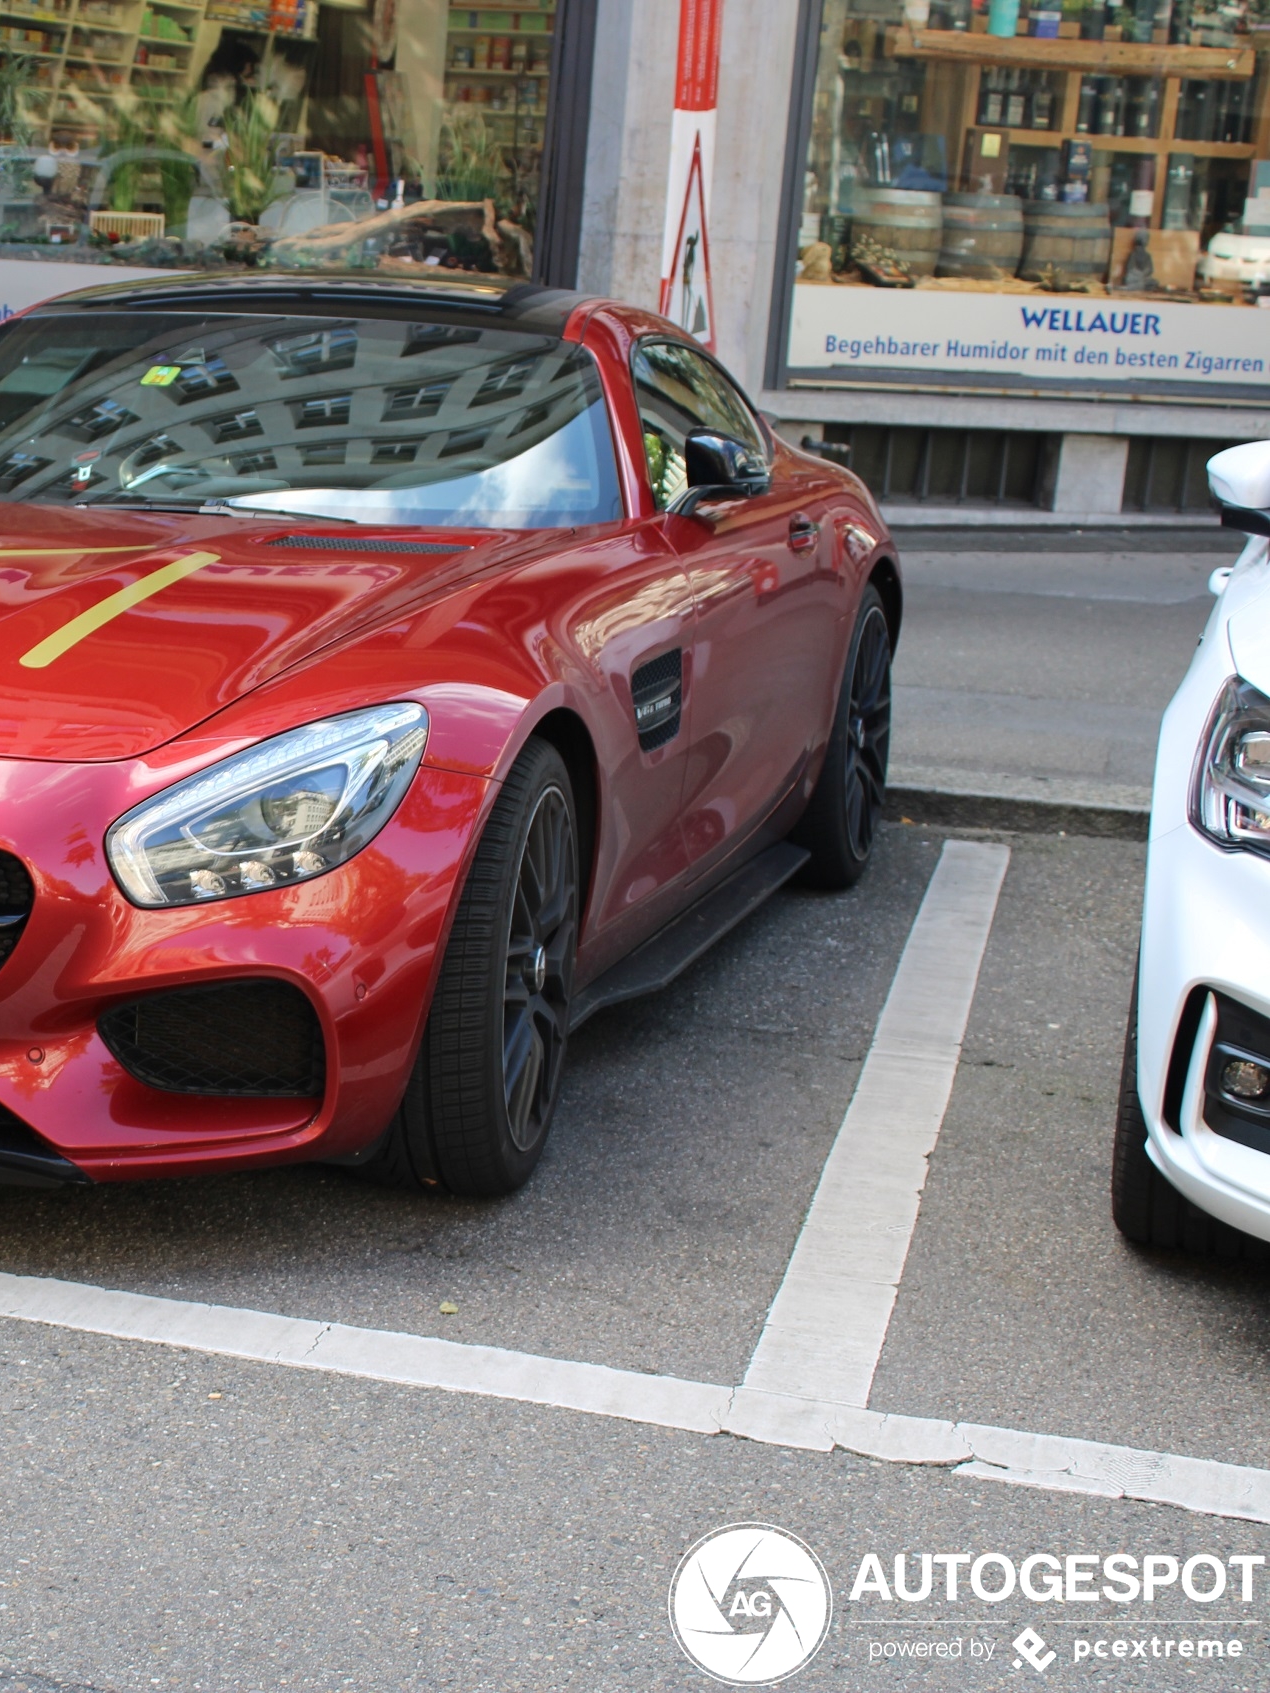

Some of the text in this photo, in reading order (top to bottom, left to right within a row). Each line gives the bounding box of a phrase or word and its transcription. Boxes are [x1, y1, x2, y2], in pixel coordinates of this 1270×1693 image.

[1021, 307, 1161, 336] WELLAUER
[825, 335, 1264, 374] Begehbarer Humidor mit den besten Zigarren
